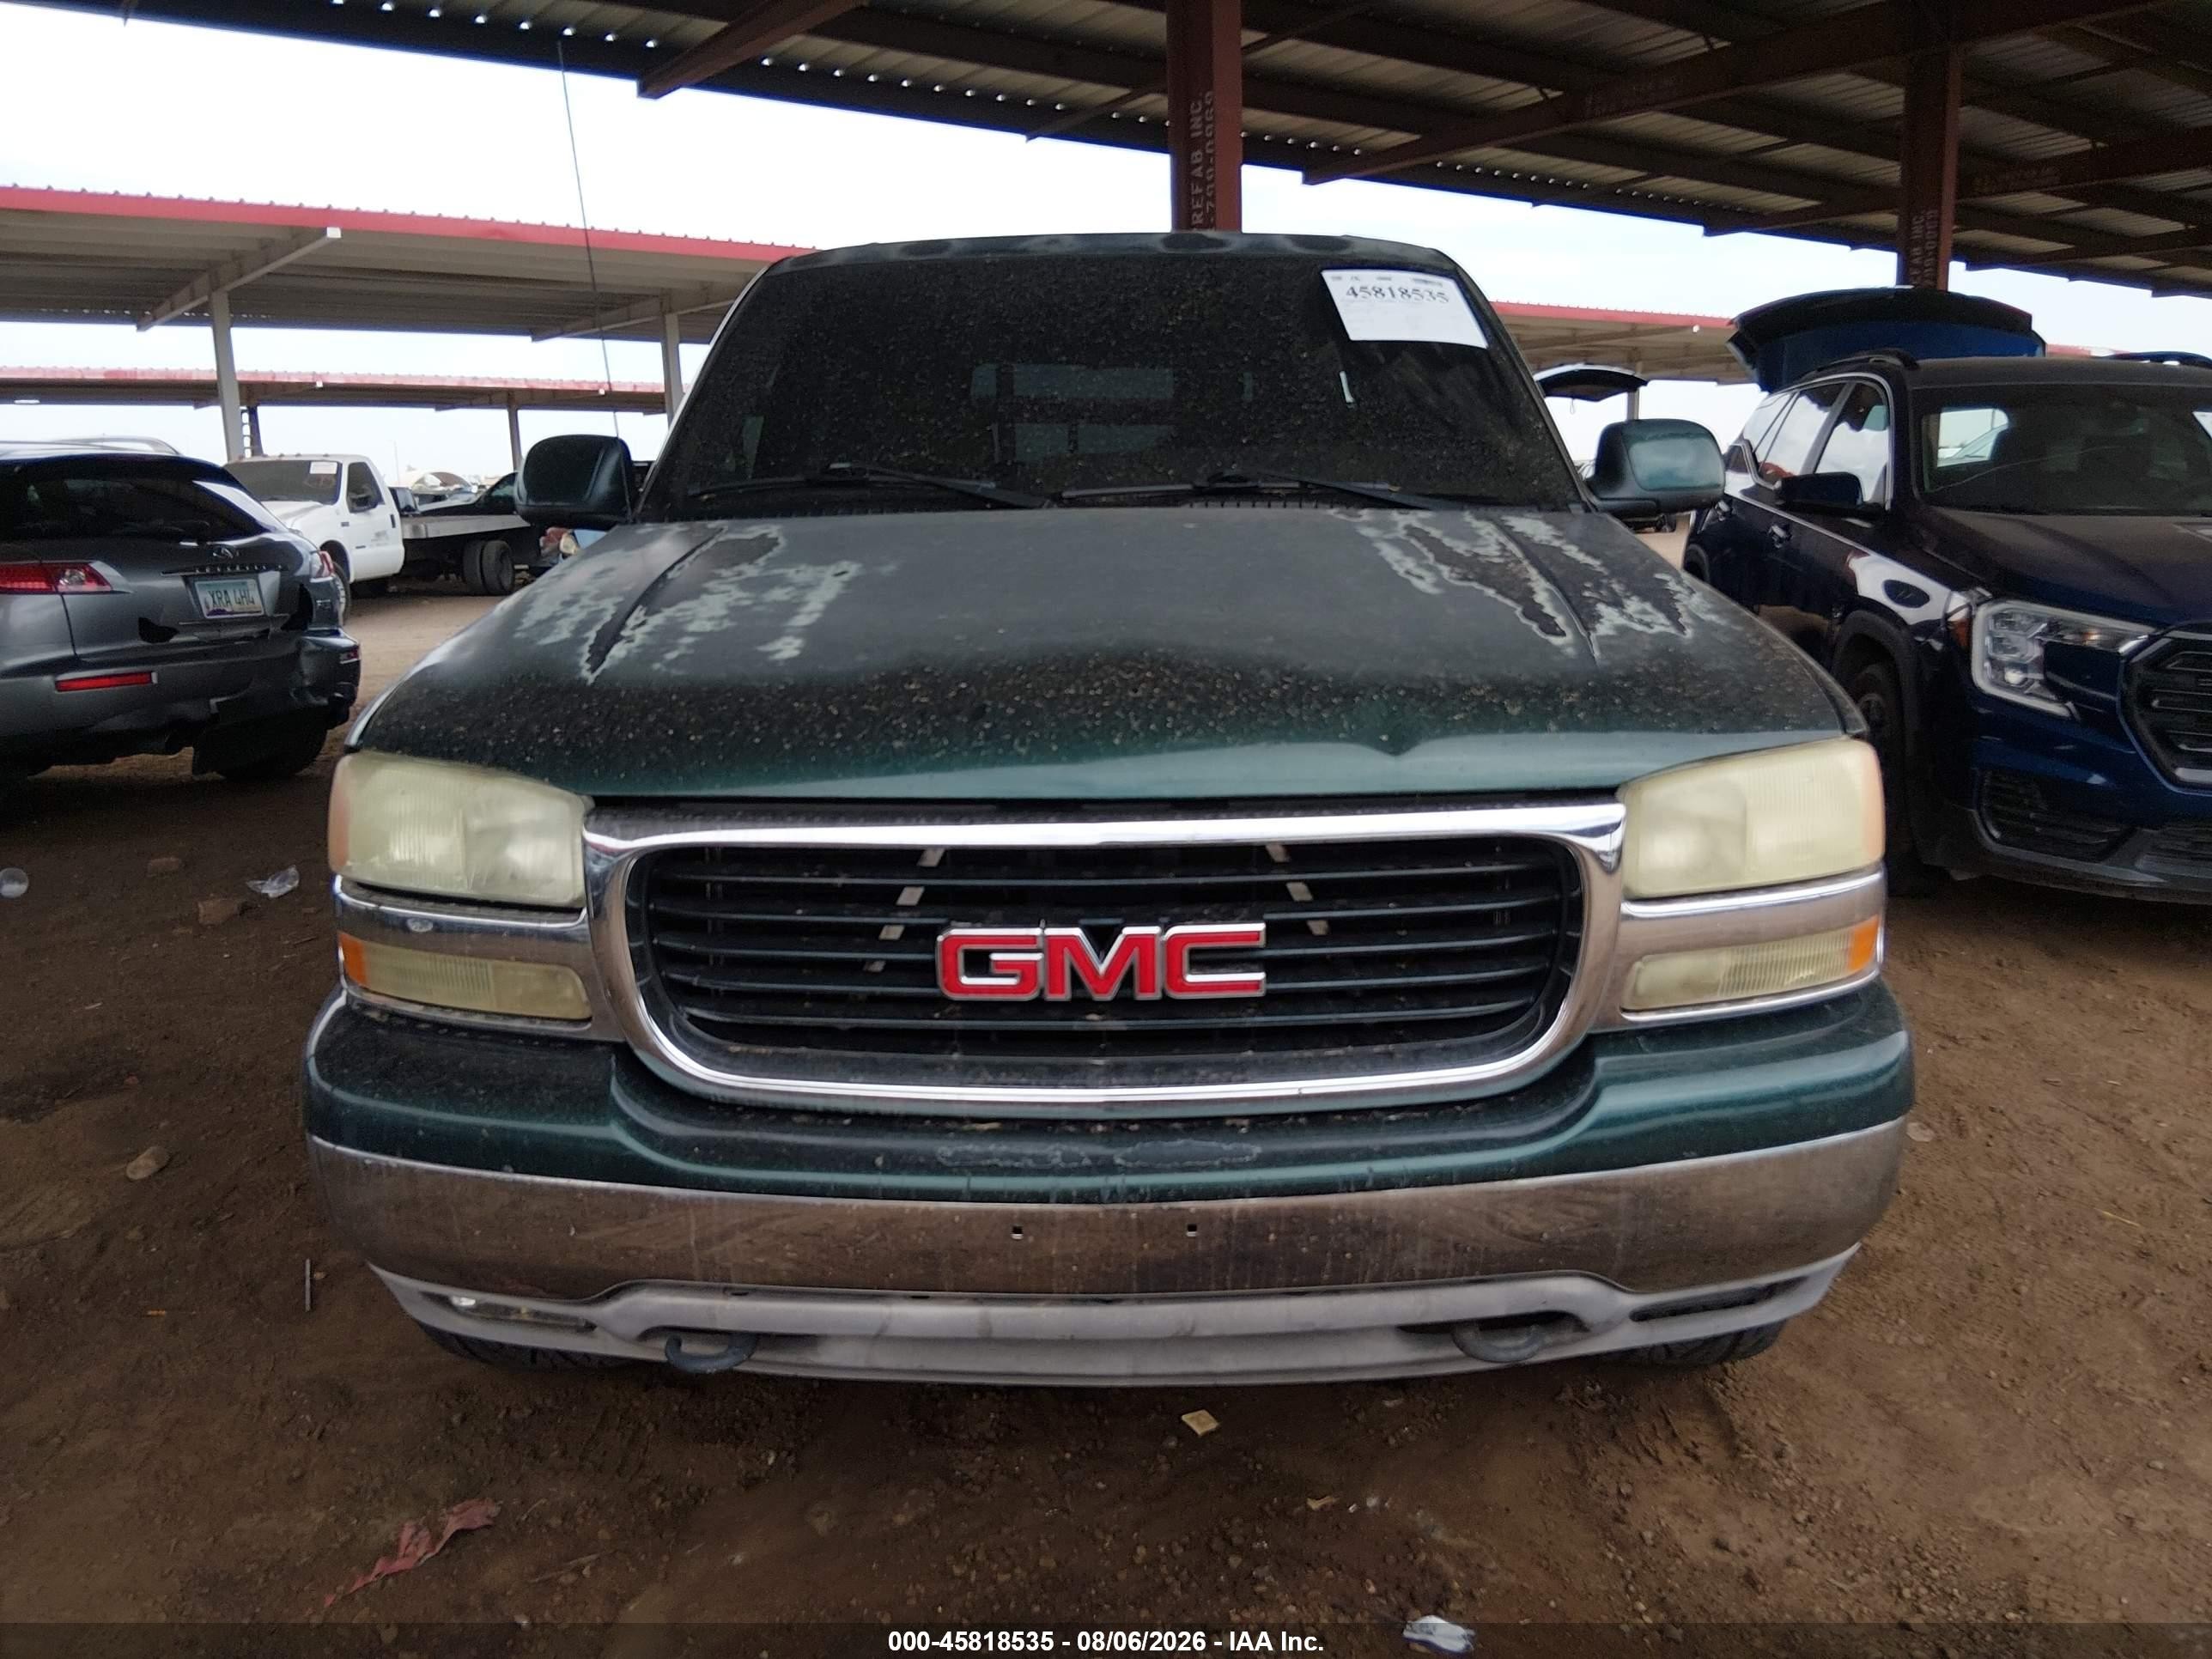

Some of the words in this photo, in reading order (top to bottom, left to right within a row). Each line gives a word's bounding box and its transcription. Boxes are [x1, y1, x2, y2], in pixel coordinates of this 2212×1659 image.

[1190, 149, 1204, 230] REFAB
[1346, 286, 1449, 303] 45818535
[937, 922, 1267, 1001] GMC
